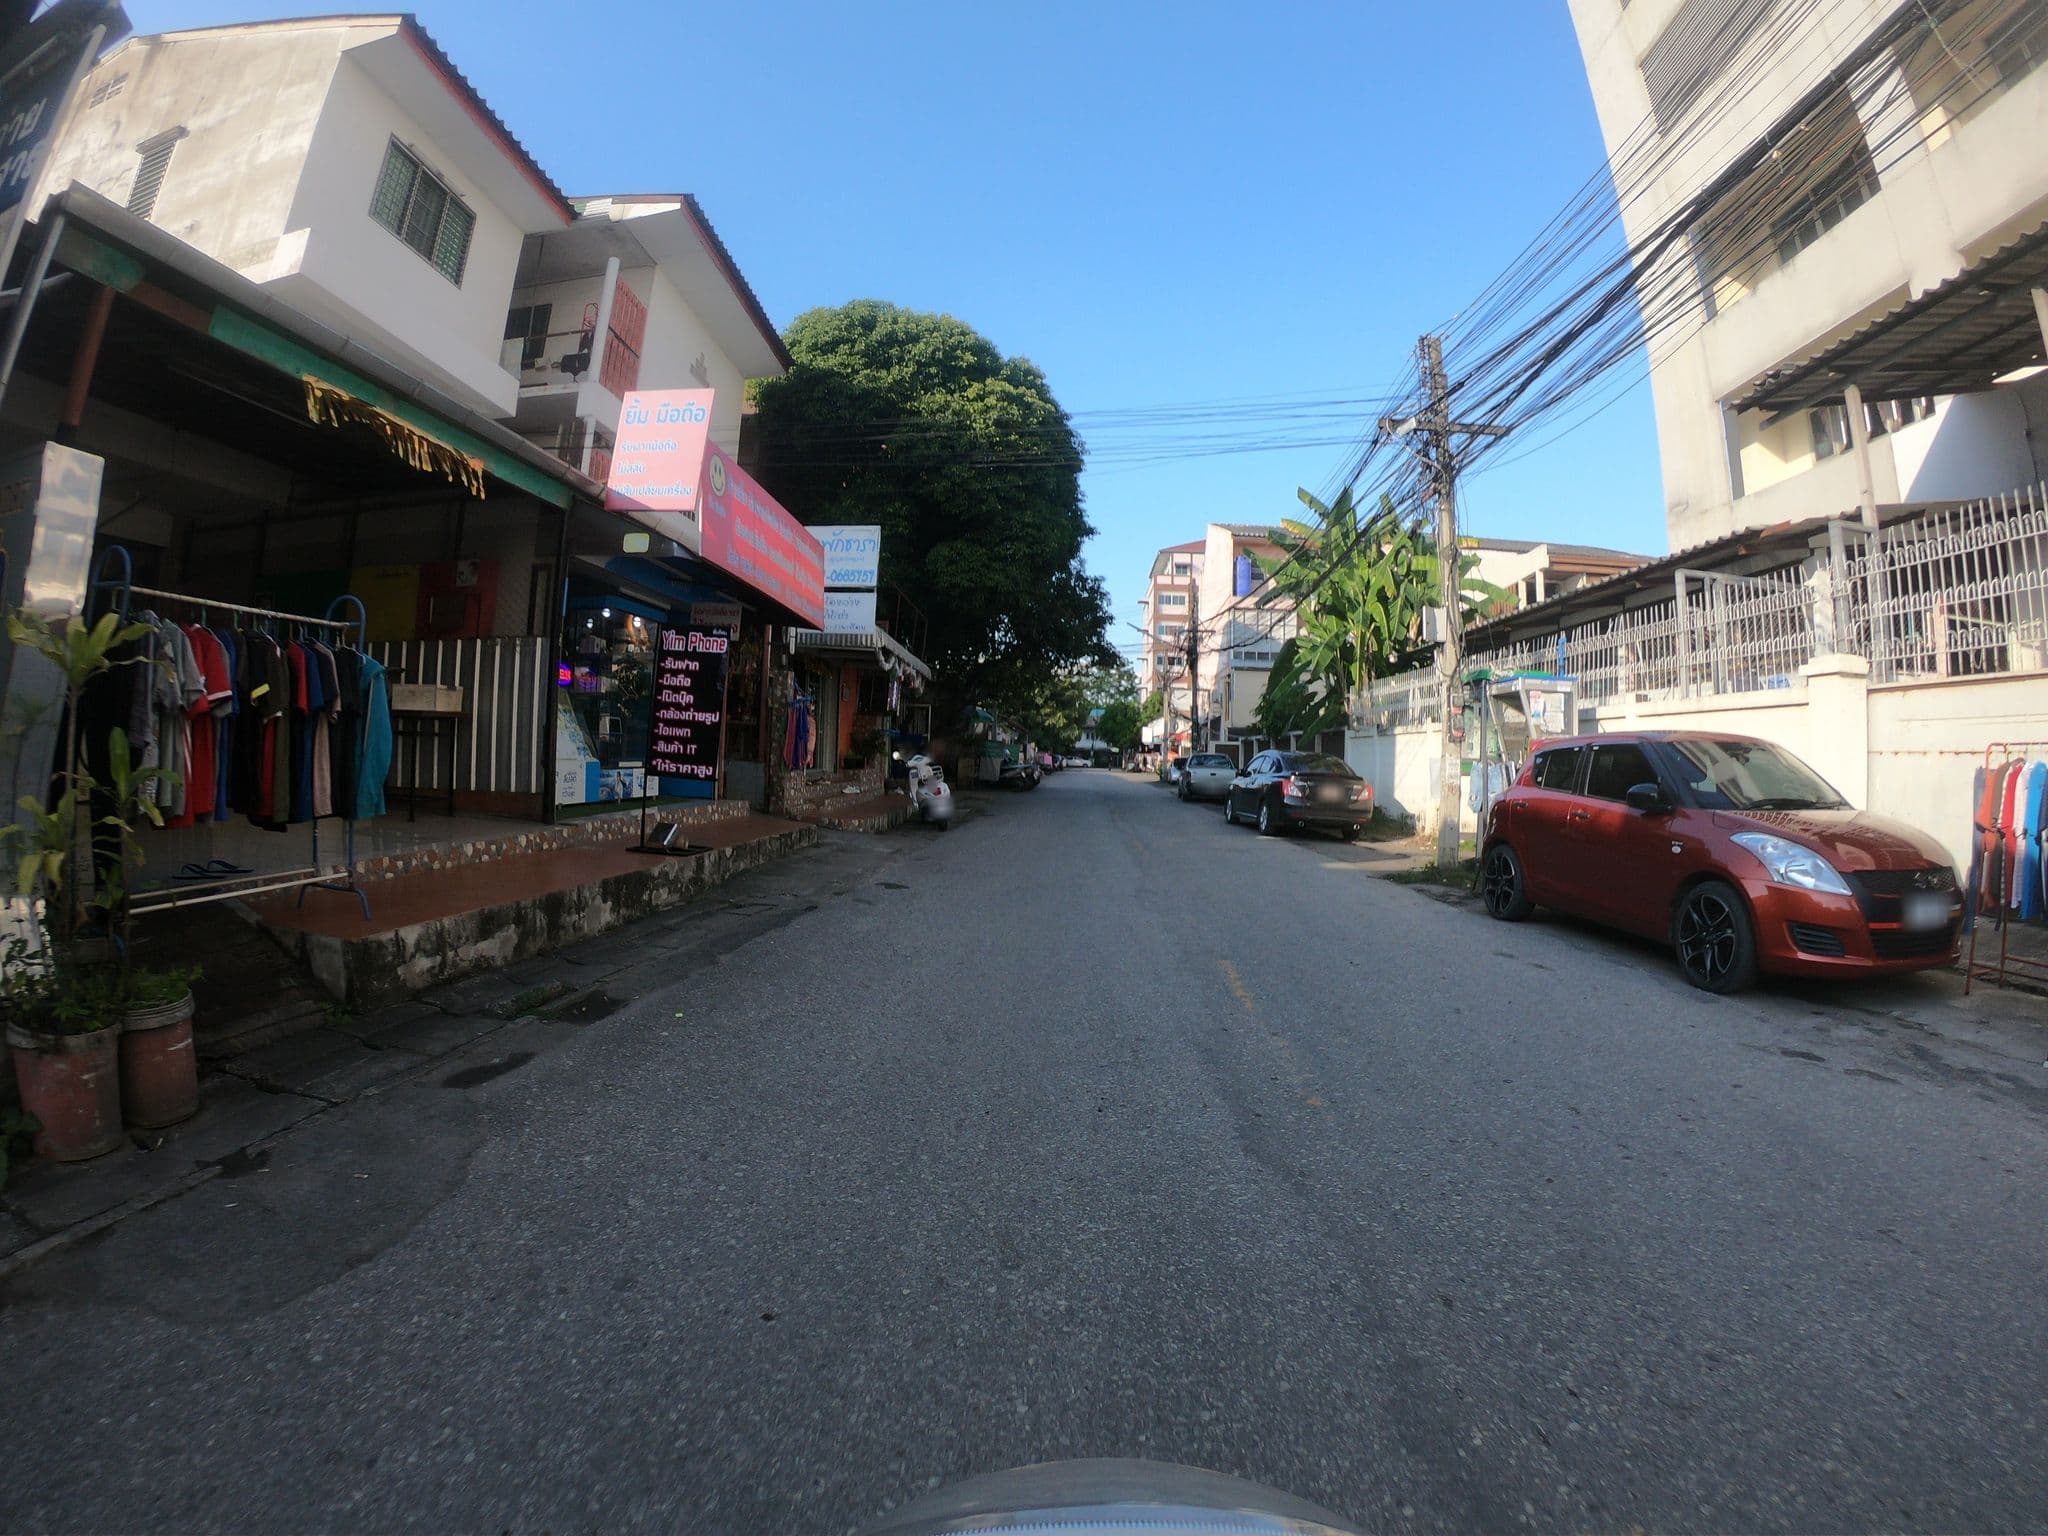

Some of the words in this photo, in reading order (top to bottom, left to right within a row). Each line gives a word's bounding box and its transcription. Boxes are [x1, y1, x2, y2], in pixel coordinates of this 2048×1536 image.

[624, 399, 650, 424] ยิ้ม
[656, 400, 706, 425] มือถือ
[662, 629, 686, 651] Yim
[688, 632, 728, 653] Phone
[687, 744, 698, 756] IT
